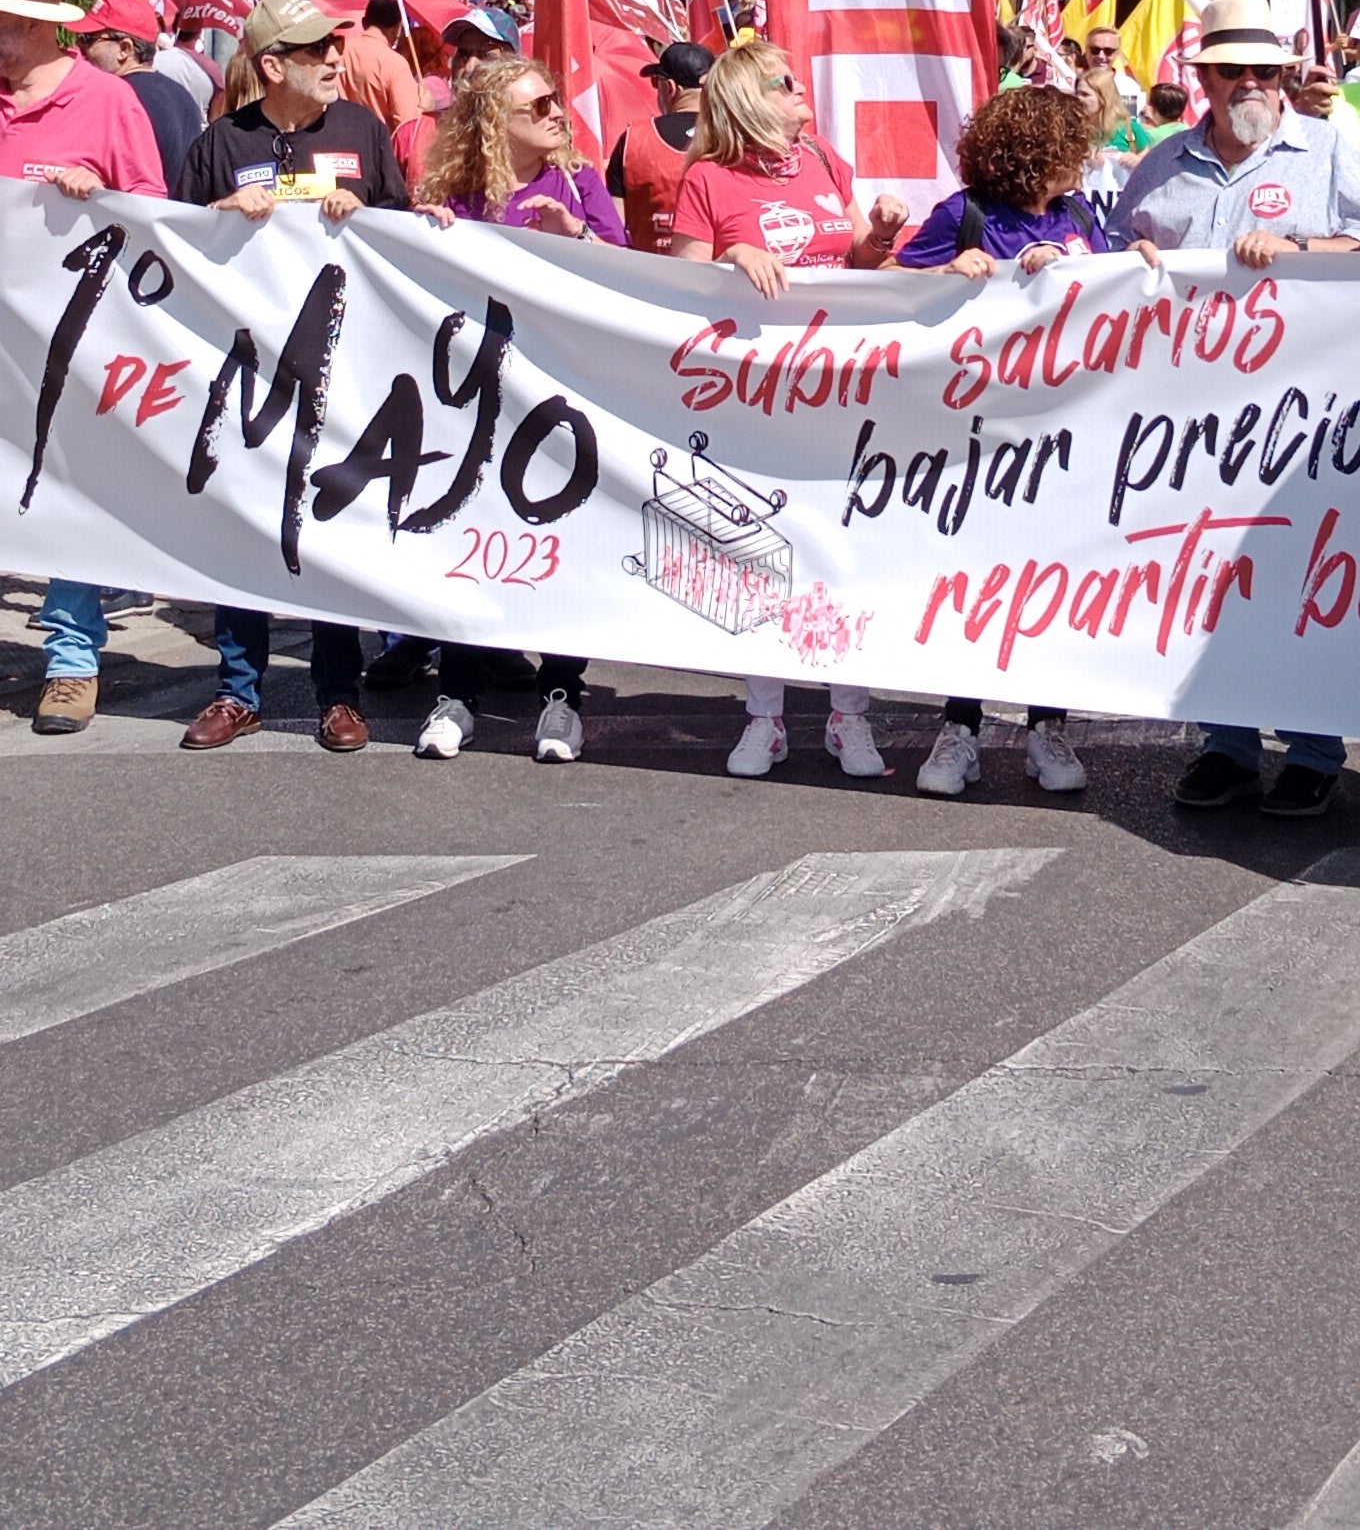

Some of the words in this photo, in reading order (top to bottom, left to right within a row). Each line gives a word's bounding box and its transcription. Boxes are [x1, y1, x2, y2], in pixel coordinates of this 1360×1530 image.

[95, 354, 193, 428] DE
[670, 308, 902, 416] Subir
[942, 276, 1286, 411] salarios
[840, 414, 1073, 537] bajar
[444, 526, 562, 592] 2023
[915, 505, 1292, 672] repartir
